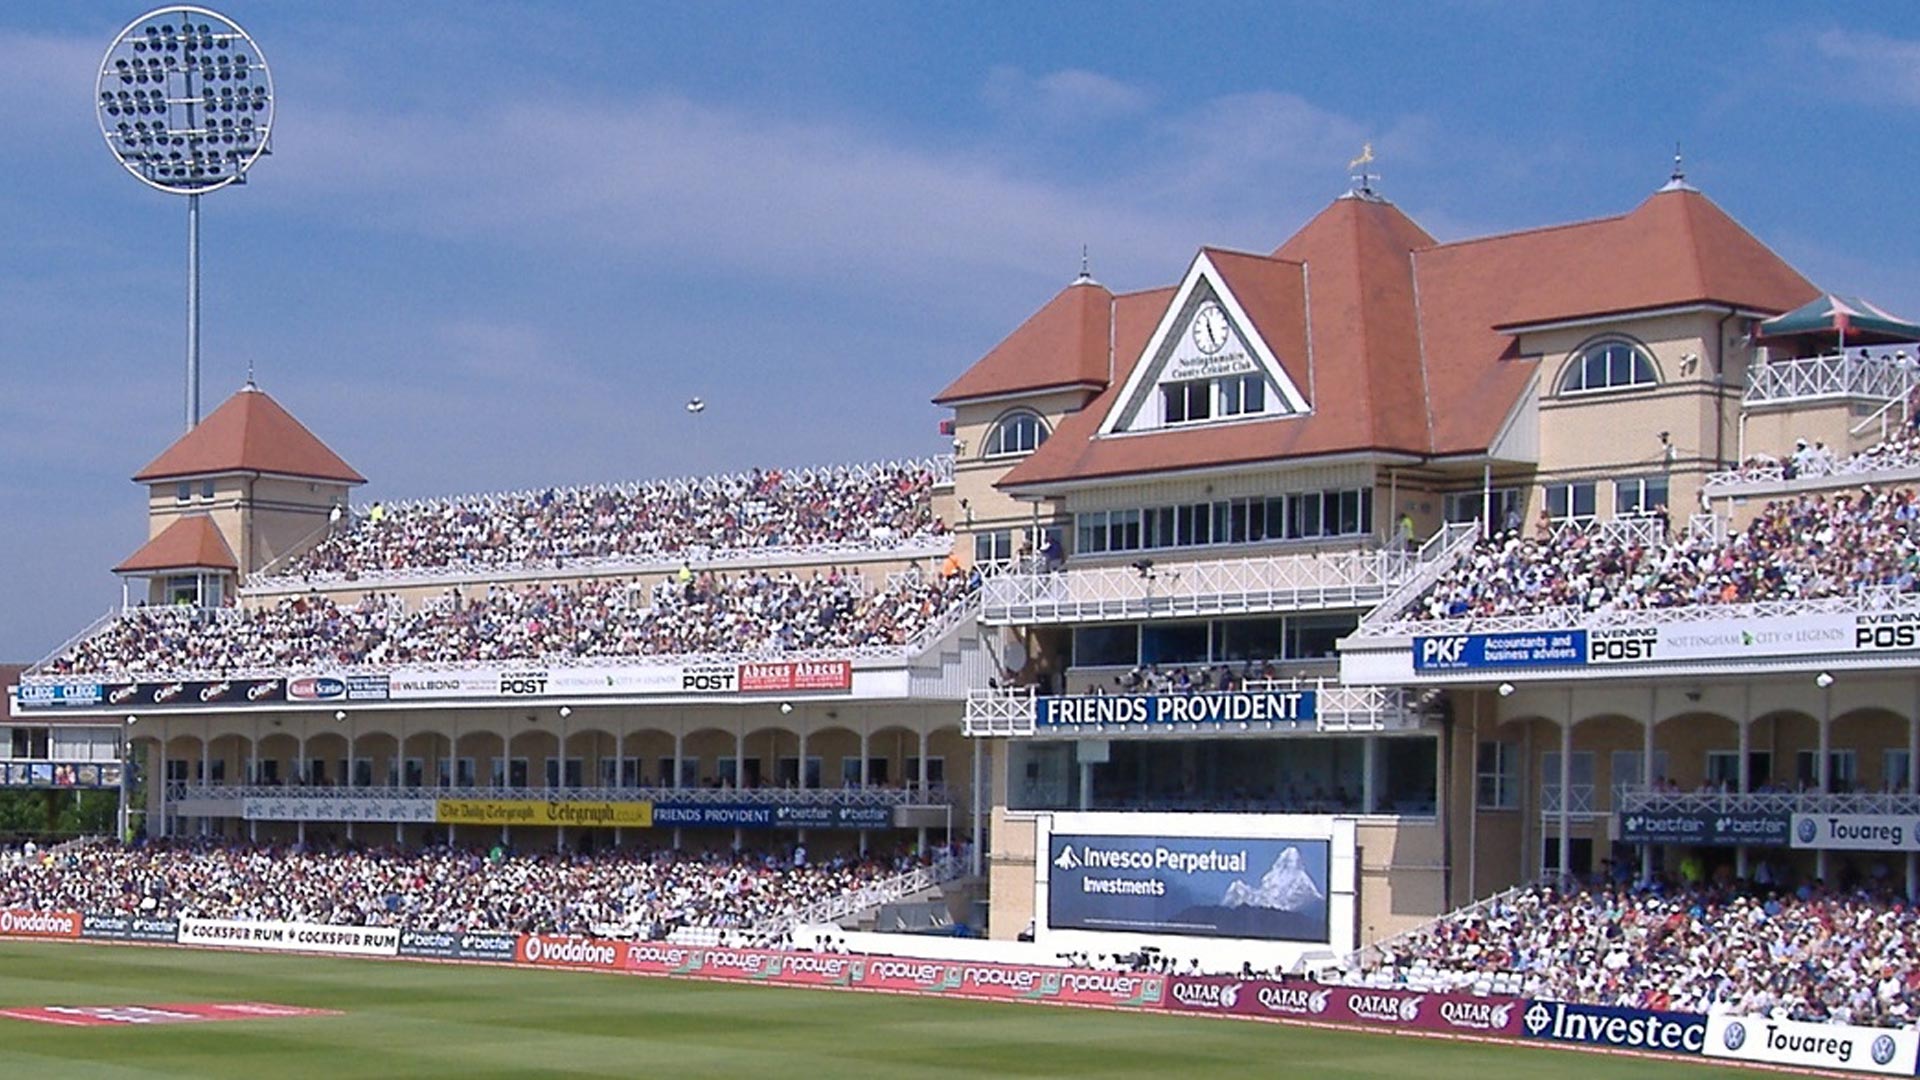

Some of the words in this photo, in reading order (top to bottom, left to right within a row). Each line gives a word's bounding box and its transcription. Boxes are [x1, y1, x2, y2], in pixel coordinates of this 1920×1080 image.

[1171, 369, 1199, 379] County
[1856, 613, 1920, 625] EVENIN
[1484, 636, 1546, 650] Accountants
[1552, 635, 1572, 647] and
[1591, 628, 1657, 639] EVENING
[1422, 637, 1468, 663] PKF
[1484, 649, 1528, 661] business
[1532, 647, 1576, 659] advisers
[1591, 639, 1657, 661] POST
[501, 680, 548, 694] POST
[683, 675, 735, 690] POST
[1046, 696, 1147, 724] FRIENDS
[1156, 693, 1302, 722] PROVIDENT
[440, 804, 459, 818] The
[462, 805, 486, 820] Daily
[487, 805, 535, 822] Telegraph
[653, 808, 701, 822] FRIENDS
[705, 809, 770, 823] PROVIDENT
[791, 807, 832, 819] betfair
[852, 808, 888, 820] betfair
[1646, 817, 1704, 832] betfair
[1733, 817, 1787, 832] betfair
[1828, 818, 1903, 846] Touareg
[1083, 847, 1151, 870] Invesco
[1155, 850, 1246, 875] Perpetual
[1083, 876, 1164, 896] Investments
[13, 914, 73, 933] vodafone
[192, 926, 250, 941] COCKSPUR
[253, 928, 284, 942] RUM
[298, 930, 360, 946] COCKSPUR
[363, 932, 397, 948] RUM
[542, 940, 616, 964] vodafone
[628, 946, 688, 964] npower
[704, 951, 767, 970] npower
[783, 956, 849, 975] npower
[871, 961, 944, 982] npower
[964, 967, 1041, 988] npower
[1061, 973, 1142, 994] npower
[1172, 982, 1220, 1005] QATAR
[1257, 987, 1308, 1010] QATAR
[1348, 993, 1400, 1018] QATAR
[1439, 1001, 1490, 1026] QATAR
[1551, 1003, 1705, 1051] Investec
[1766, 1025, 1853, 1062] Touareg
